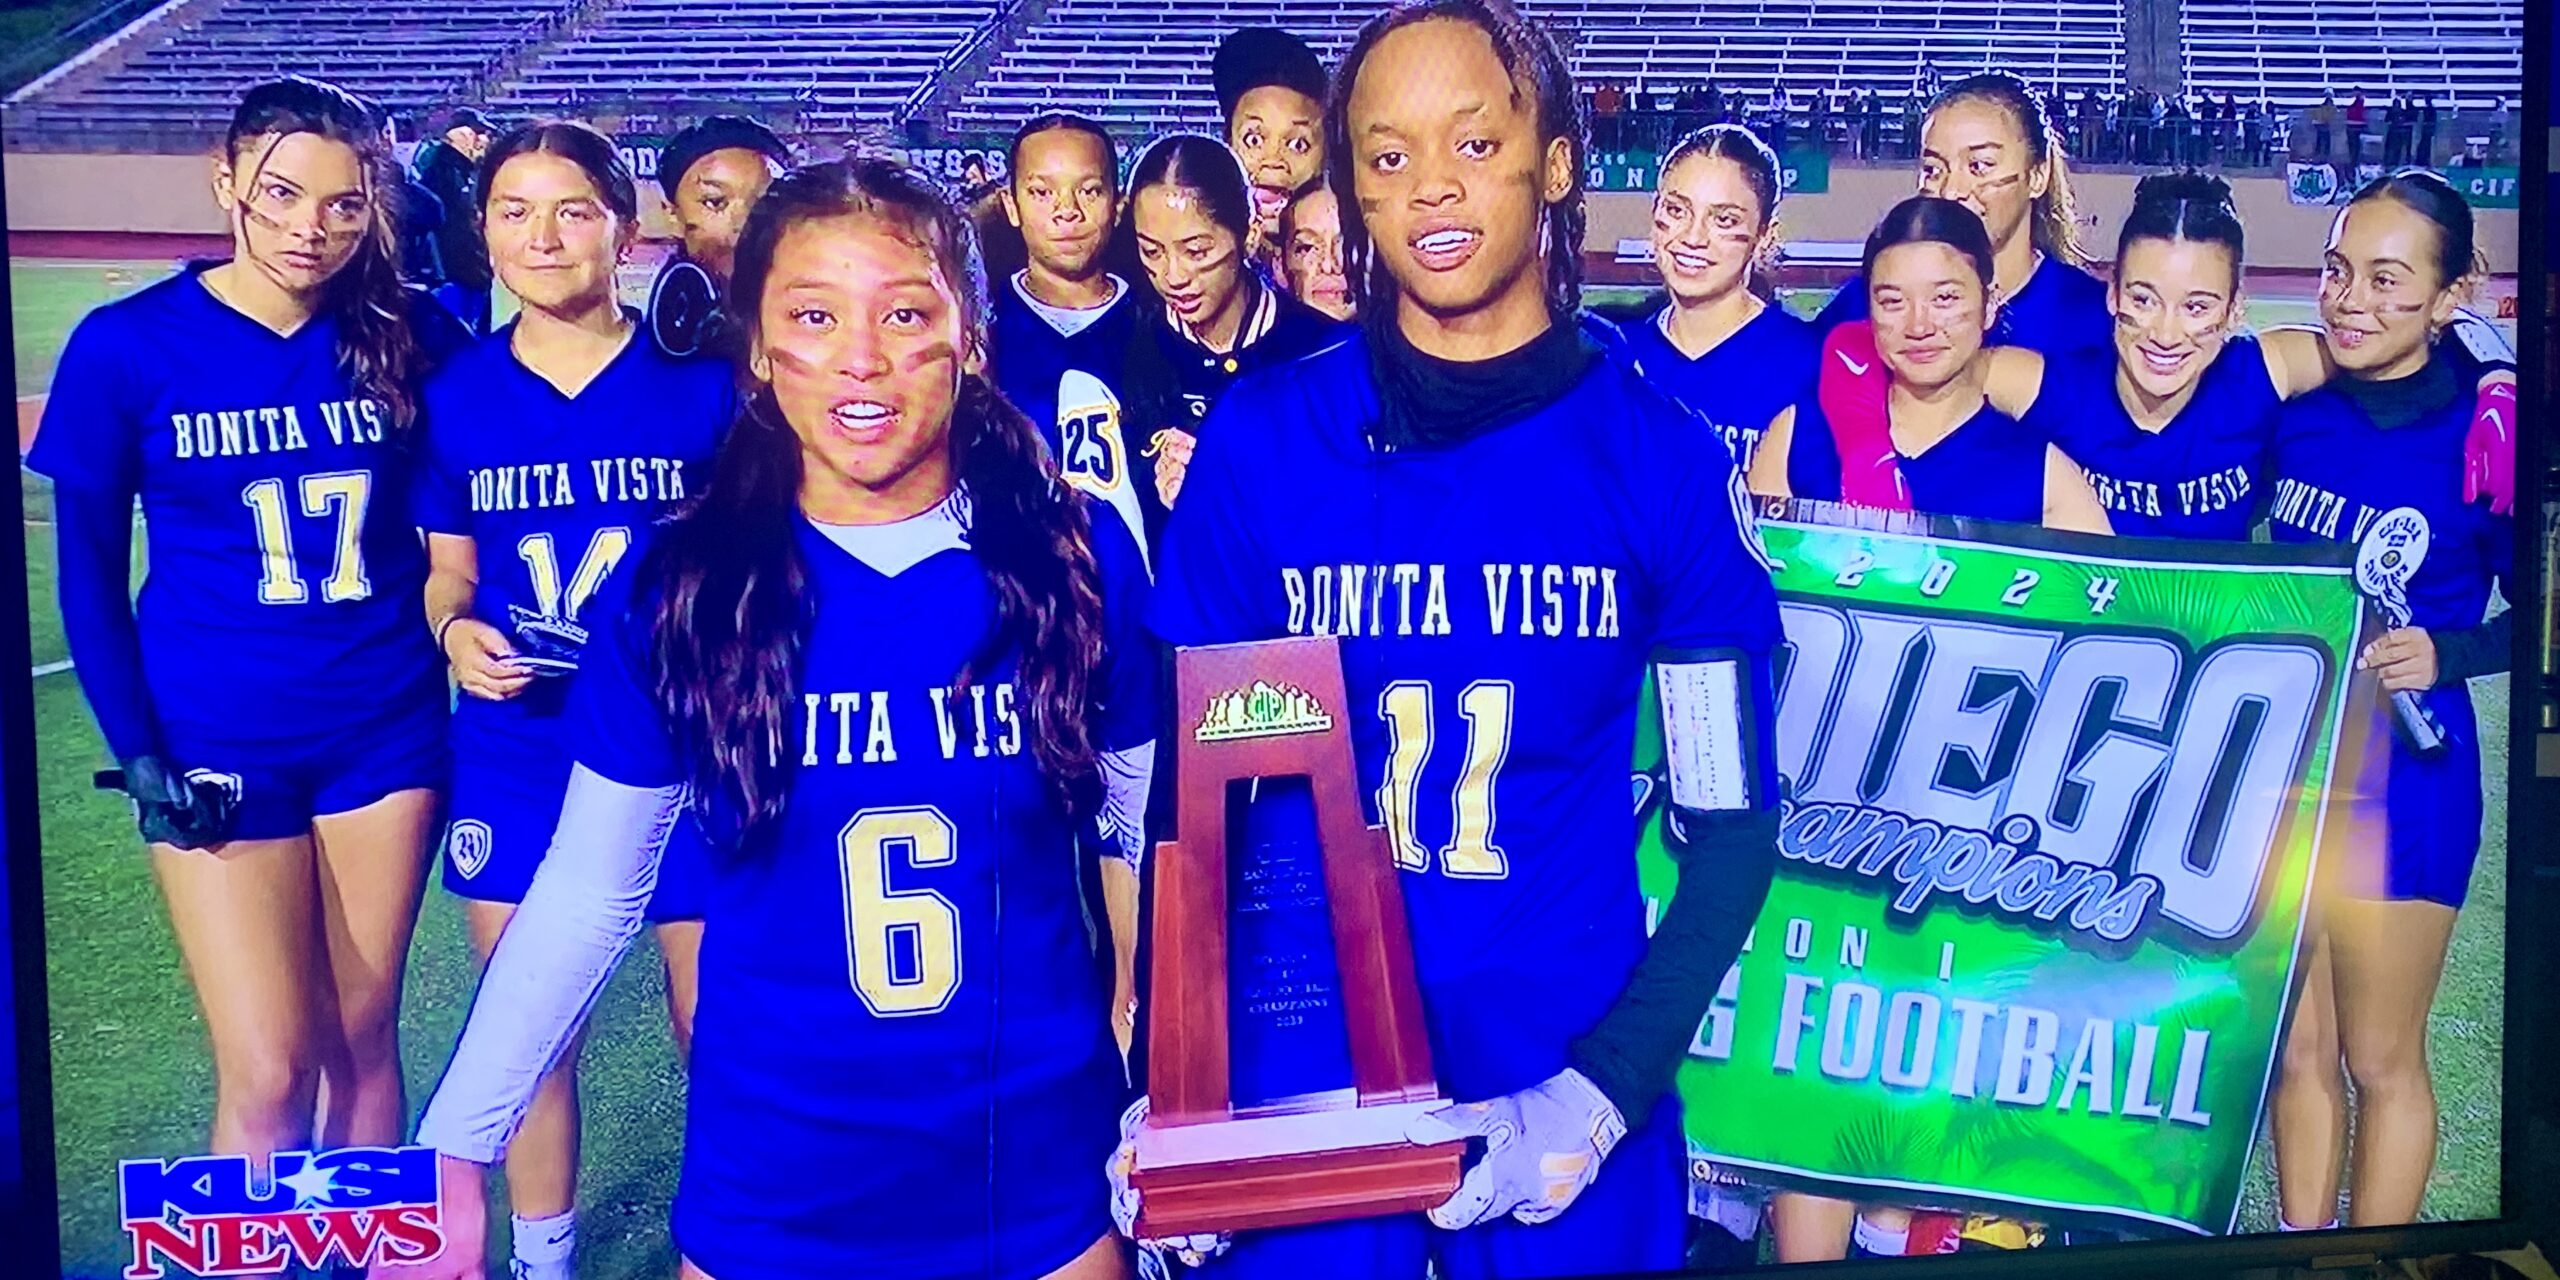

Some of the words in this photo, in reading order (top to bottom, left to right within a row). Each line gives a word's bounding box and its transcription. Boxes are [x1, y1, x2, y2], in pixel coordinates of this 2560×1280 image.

[2470, 178, 2517, 196] CIF
[171, 405, 309, 458] BONITA
[1064, 411, 1116, 485] 25
[591, 457, 685, 503] VISTA
[241, 469, 373, 605] 17
[1281, 562, 1451, 637] BONITA
[1482, 563, 1620, 638] VISTA
[1834, 550, 2121, 616] 2024
[1375, 679, 1514, 879] 11
[1776, 801, 2155, 941] ampions
[837, 804, 962, 1018] 6
[1772, 972, 2212, 1127] FOOTBALL
[119, 1147, 442, 1224] KUSI
[123, 1203, 447, 1280] NEWS
